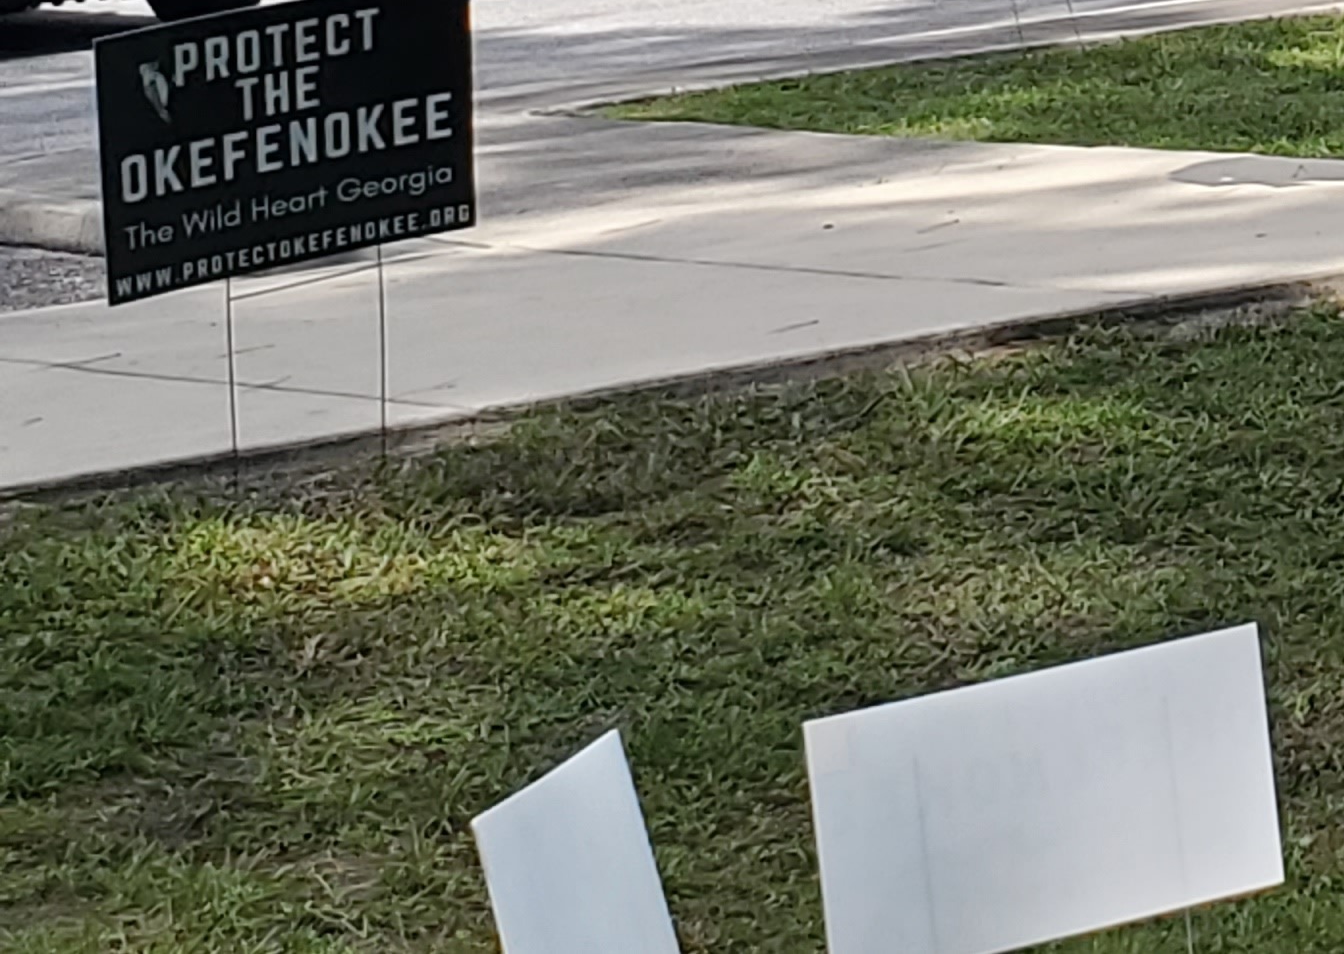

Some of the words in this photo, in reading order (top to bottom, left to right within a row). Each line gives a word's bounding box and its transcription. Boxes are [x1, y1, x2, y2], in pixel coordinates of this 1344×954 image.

[174, 8, 380, 87] PROTECT
[235, 66, 320, 121] THE
[121, 92, 452, 203] OKEFENOKEE
[125, 224, 174, 250] The
[183, 201, 241, 236] Wild
[252, 187, 327, 221] Heart
[337, 164, 453, 204] Georgia
[116, 204, 471, 297] WWW.PROTECTOKEFENOKEE.ORG
